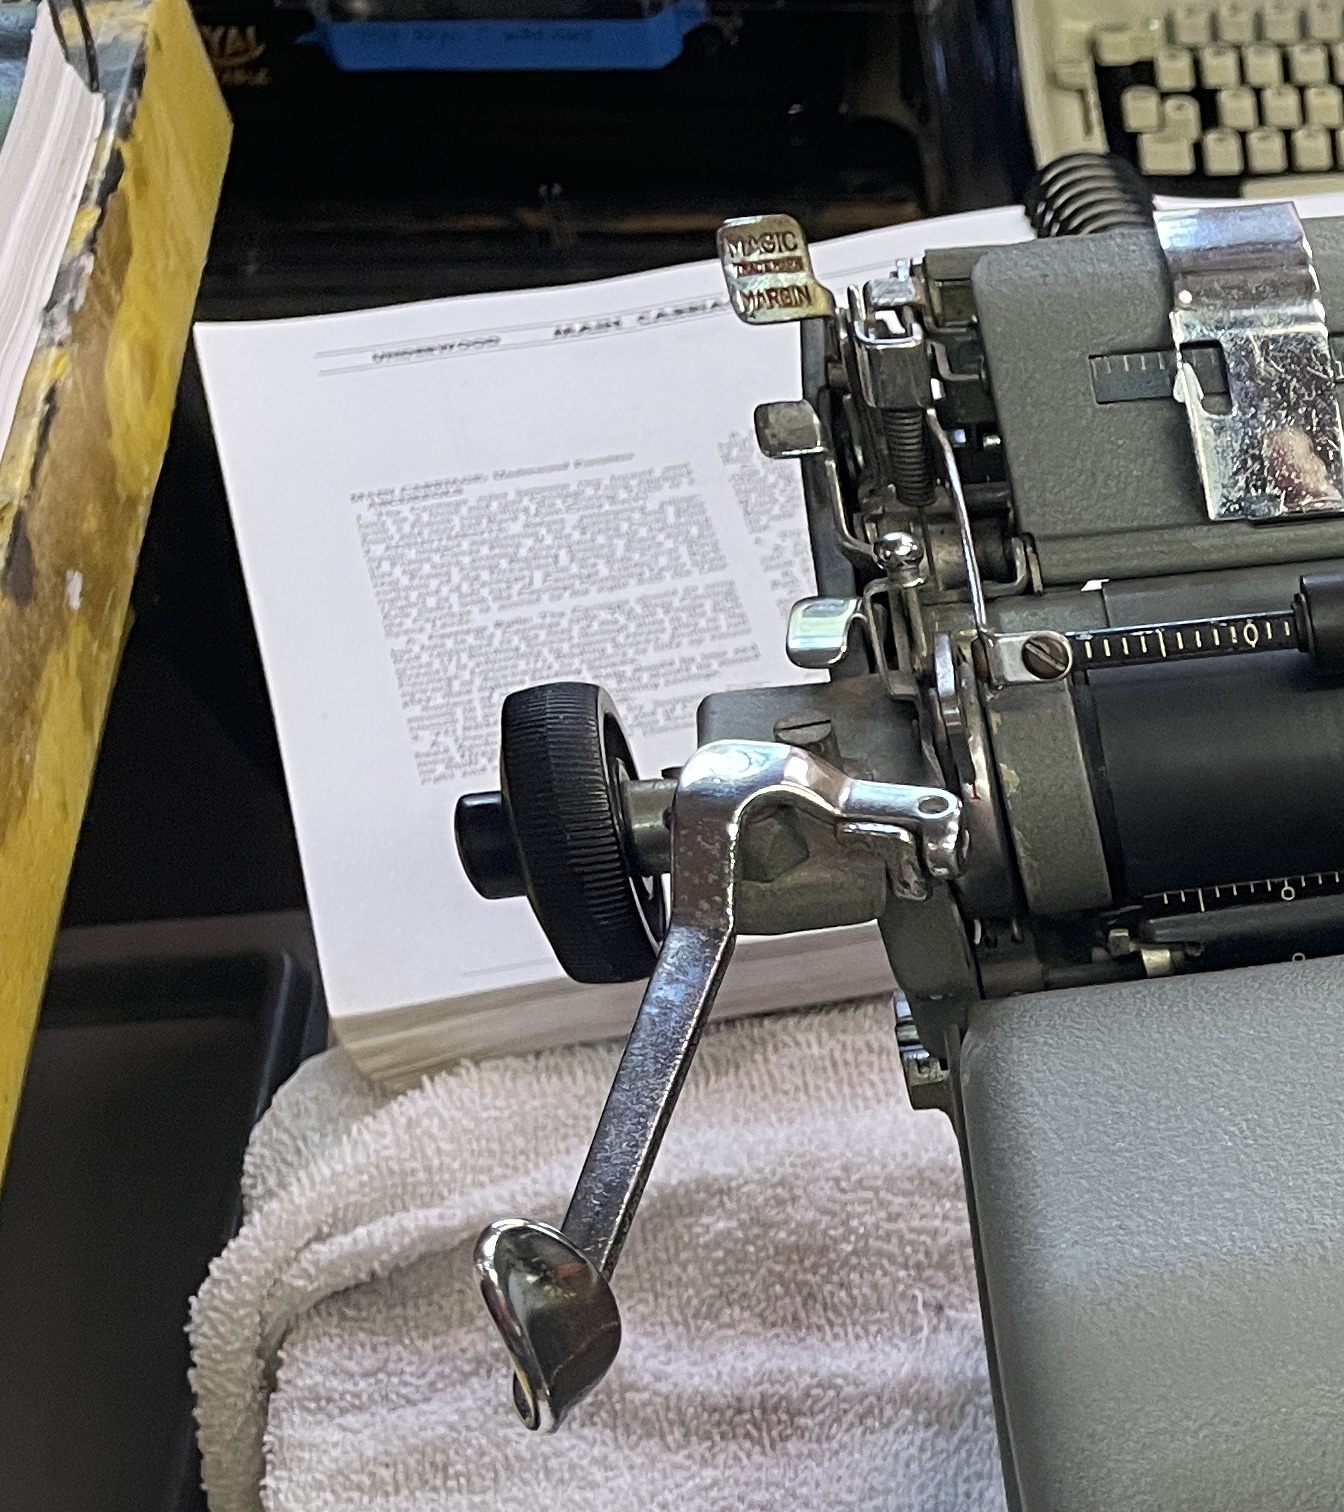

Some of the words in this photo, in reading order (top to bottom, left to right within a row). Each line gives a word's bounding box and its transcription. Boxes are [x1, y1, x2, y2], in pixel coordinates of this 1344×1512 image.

[723, 230, 798, 258] MAGIC
[740, 285, 812, 311] MARGIN
[1281, 886, 1295, 900] 0
